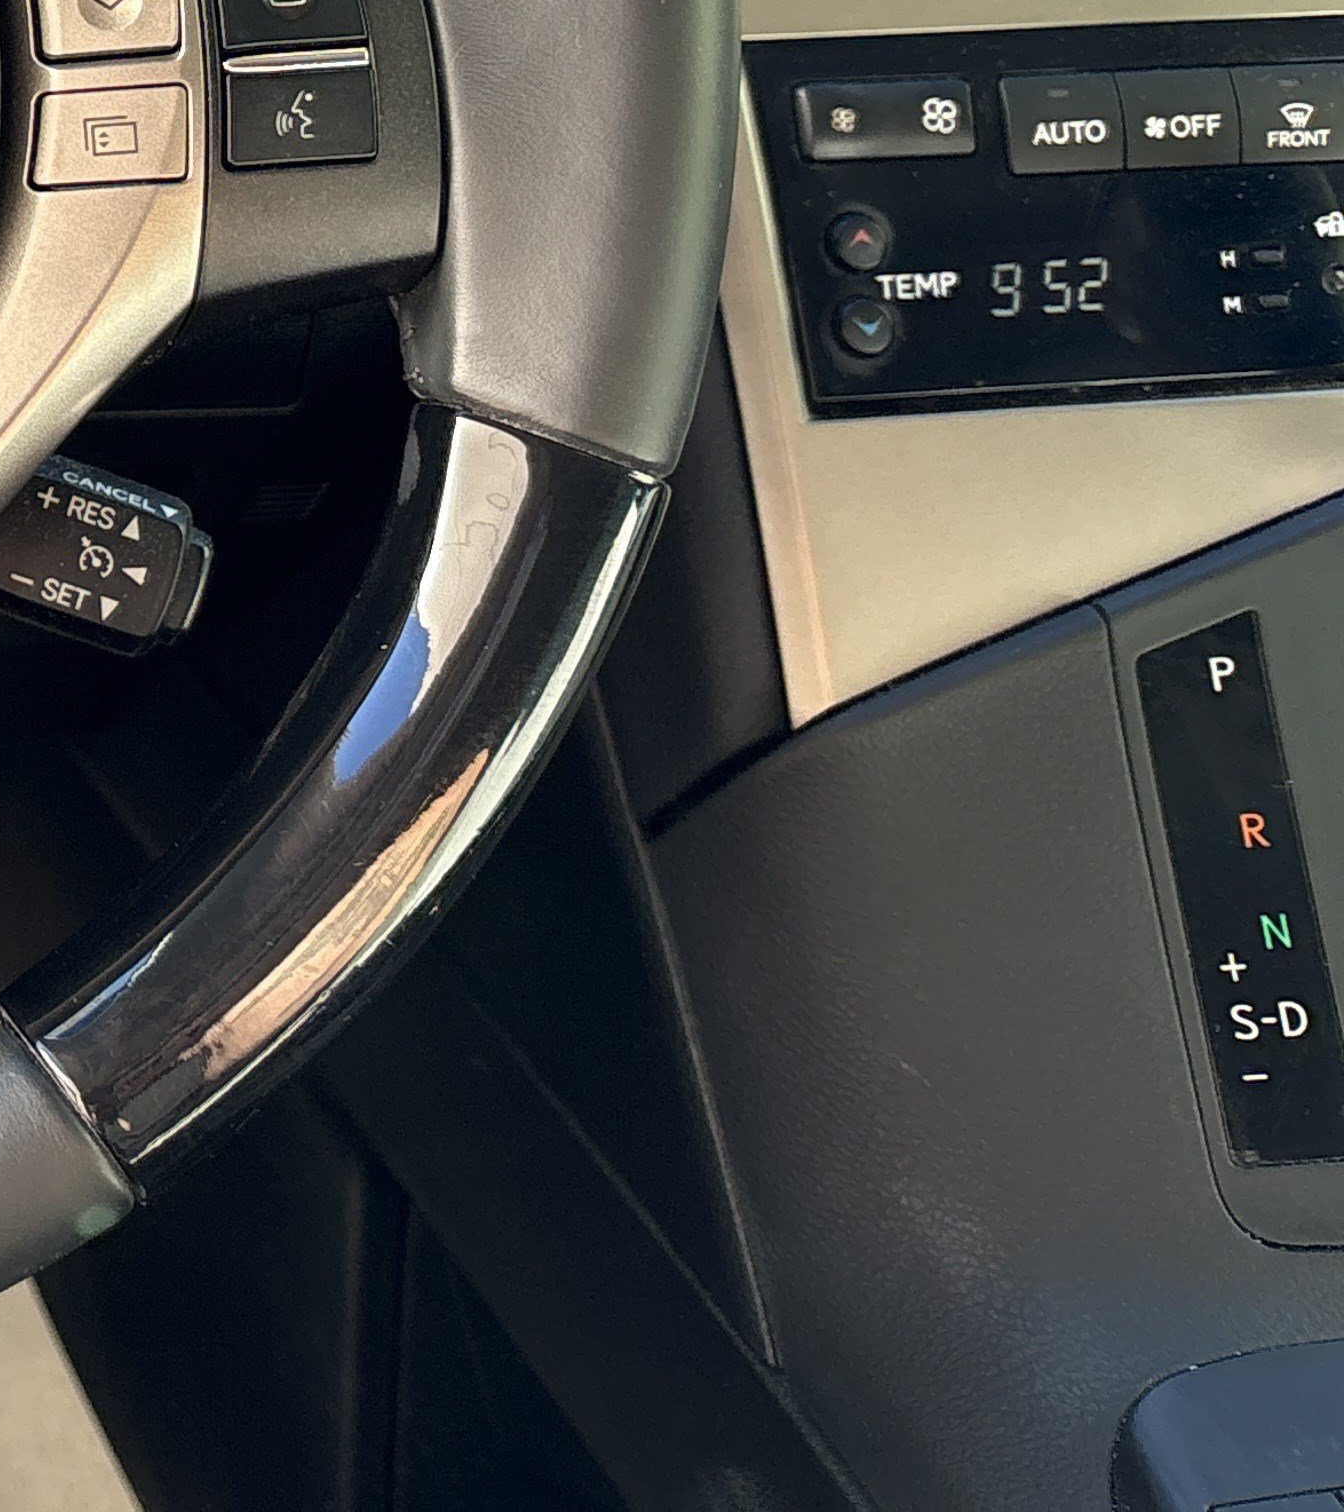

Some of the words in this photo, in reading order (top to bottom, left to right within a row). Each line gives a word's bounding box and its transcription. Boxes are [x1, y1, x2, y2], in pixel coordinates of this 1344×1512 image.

[1033, 120, 1106, 145] AUTO
[1169, 114, 1221, 138] OFF
[1266, 128, 1332, 148] FRONT
[1220, 251, 1236, 267] H
[876, 272, 958, 299] TEMP
[1223, 297, 1241, 313] M
[62, 471, 156, 514] CANCEL
[66, 495, 116, 530] RES
[41, 578, 91, 610] SET
[1209, 657, 1234, 691] P
[1240, 814, 1270, 848] R
[1260, 914, 1291, 949] N
